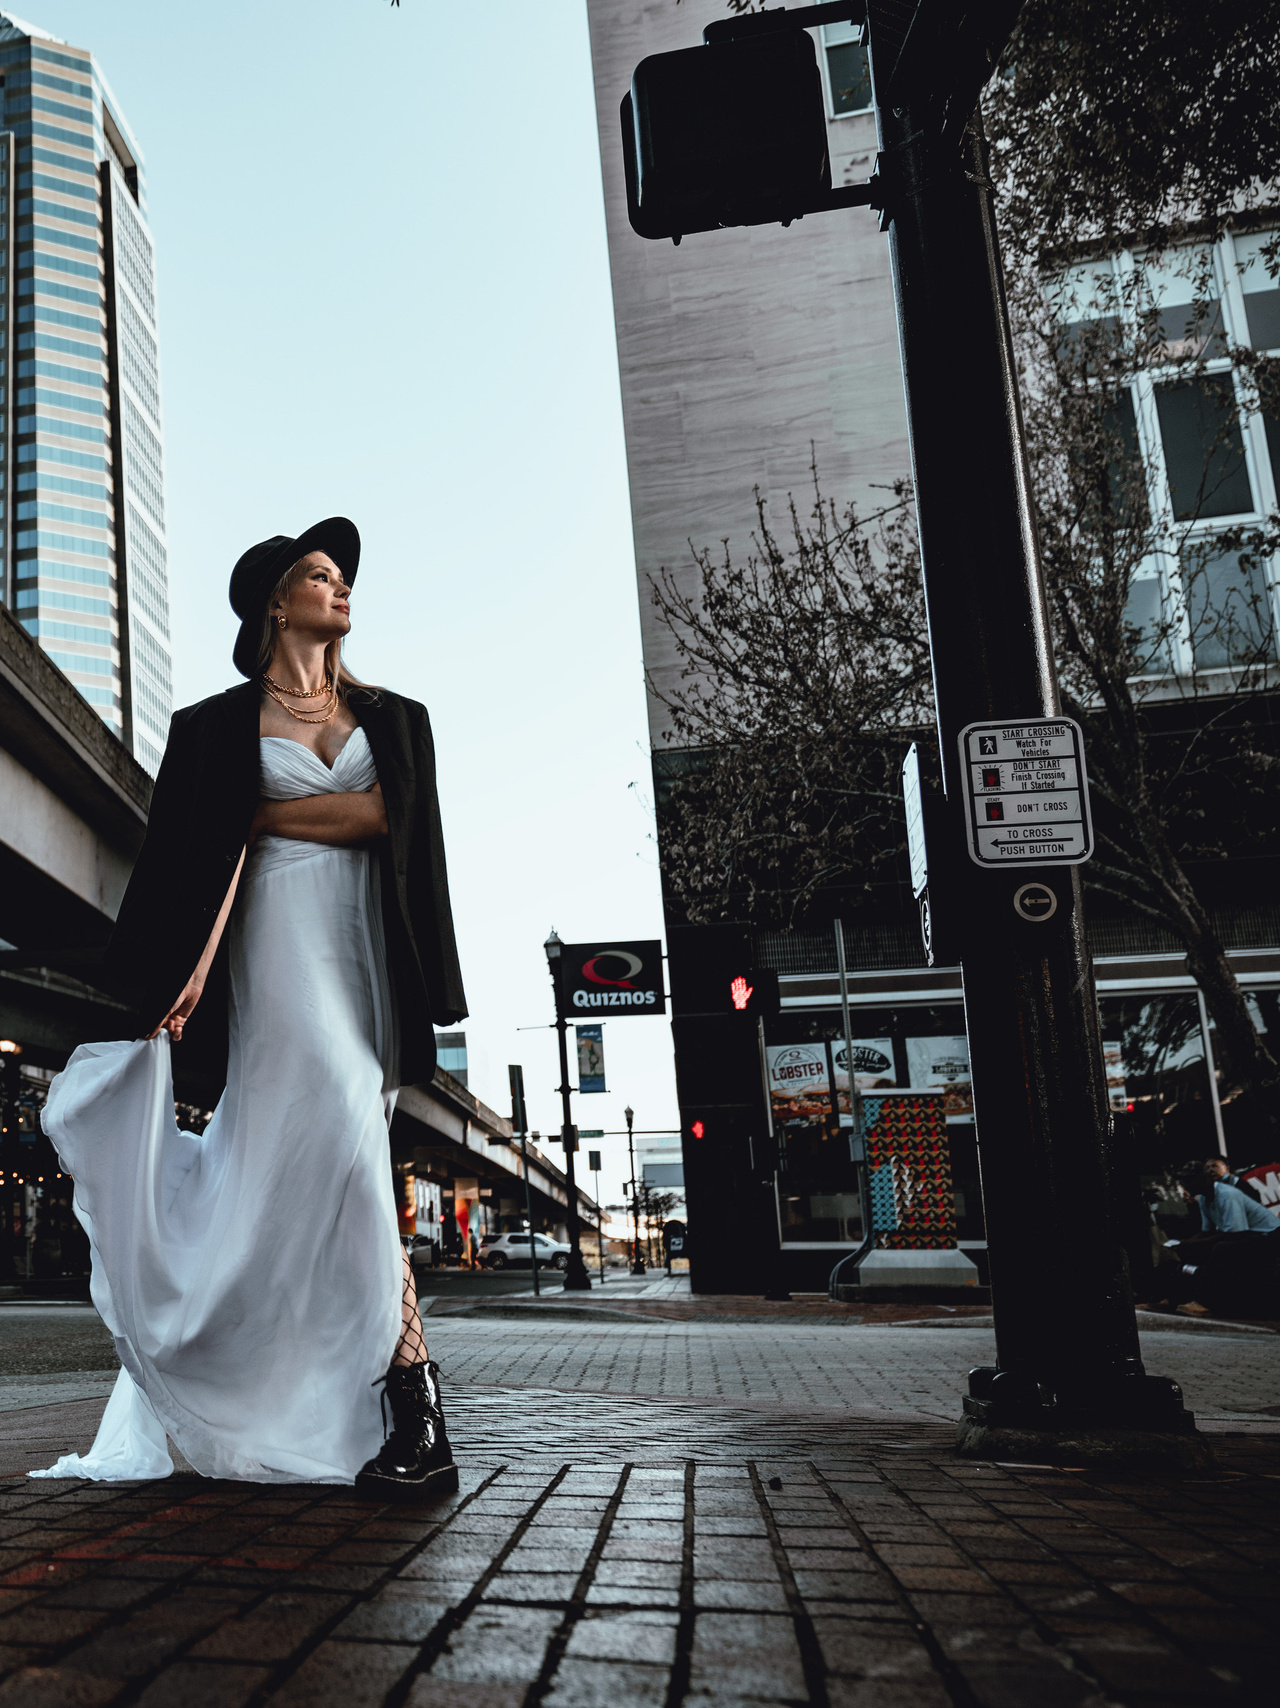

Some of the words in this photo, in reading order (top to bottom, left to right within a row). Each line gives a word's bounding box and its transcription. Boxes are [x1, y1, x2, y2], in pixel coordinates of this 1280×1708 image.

[1002, 729, 1024, 739] START
[1028, 726, 1065, 737] CROSSING
[1016, 740, 1036, 748] Watch
[1040, 739, 1051, 747] For
[1021, 748, 1049, 757] Vehicles
[1013, 761, 1035, 770] DON'T
[1039, 760, 1060, 769] START
[1011, 773, 1032, 781] Finish
[1036, 771, 1065, 781] Crossing
[1021, 782, 1027, 790] If
[1031, 780, 1055, 790] Started
[1017, 803, 1039, 813] DON'T
[1043, 802, 1068, 811] CROSS
[1007, 830, 1018, 839] TO
[1023, 828, 1053, 838] CROSS
[1000, 846, 1025, 855] PUSH
[1029, 844, 1064, 854] BUTTON
[772, 1062, 824, 1081] LOBSTER
